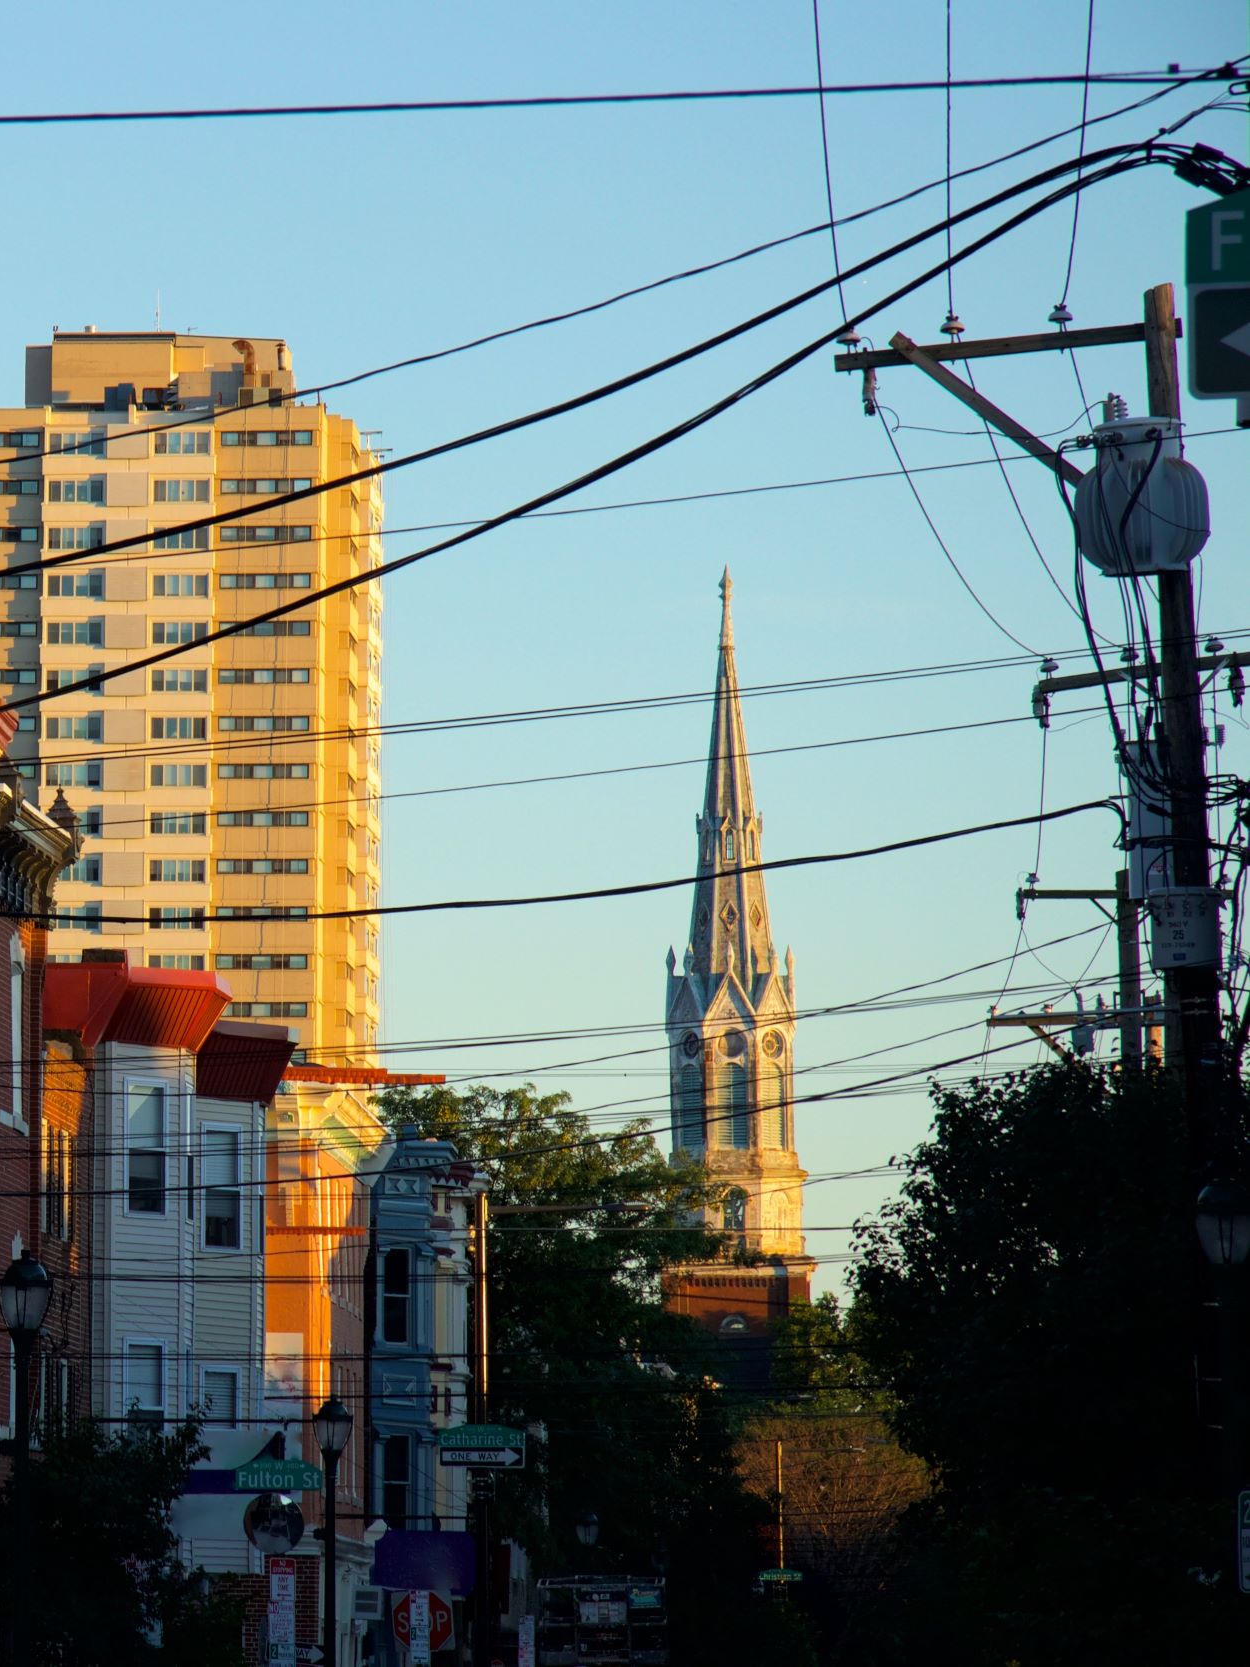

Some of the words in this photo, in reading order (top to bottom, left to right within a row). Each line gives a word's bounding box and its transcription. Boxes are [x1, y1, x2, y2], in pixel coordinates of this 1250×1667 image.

[1173, 930, 1184, 940] 25
[440, 1432, 504, 1446] Catharine
[509, 1433, 522, 1446] St
[450, 1452, 471, 1461] ONE
[478, 1452, 500, 1461] WAY
[274, 1461, 284, 1471] W
[238, 1471, 295, 1488] Fulton
[302, 1471, 319, 1488] St
[398, 1610, 448, 1633] SP
[271, 1645, 277, 1658] 2
